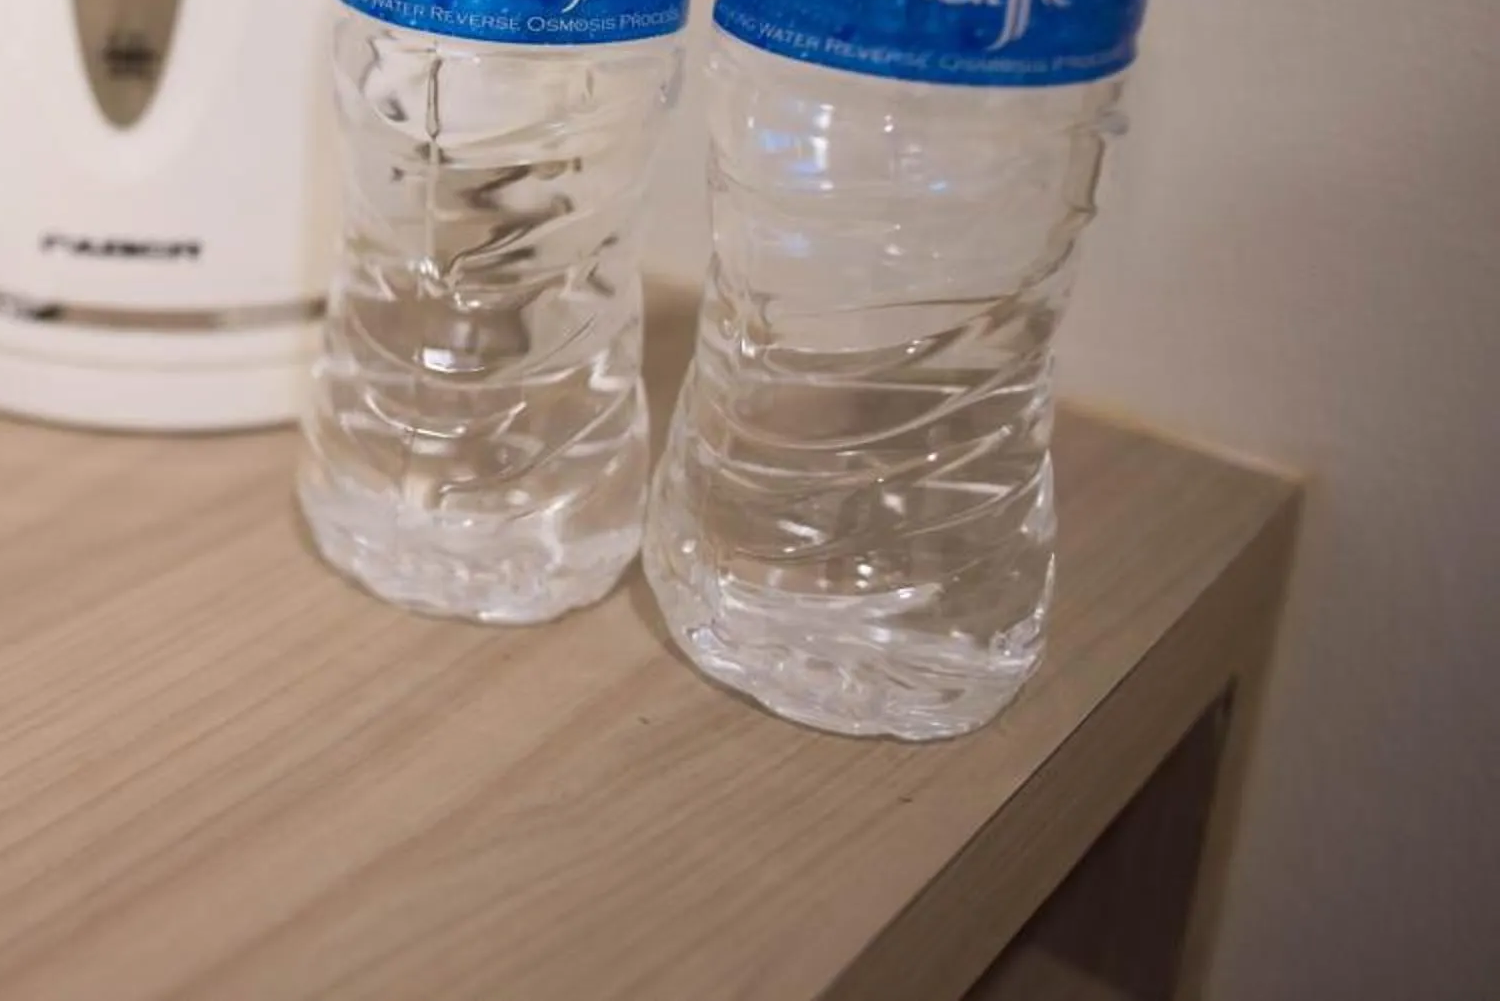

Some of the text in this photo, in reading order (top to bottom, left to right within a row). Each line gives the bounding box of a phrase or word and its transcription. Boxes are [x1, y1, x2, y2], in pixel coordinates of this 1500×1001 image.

[430, 5, 521, 33] REVERSE
[527, 15, 616, 33] OSMOSIS
[759, 12, 820, 52] WATER
